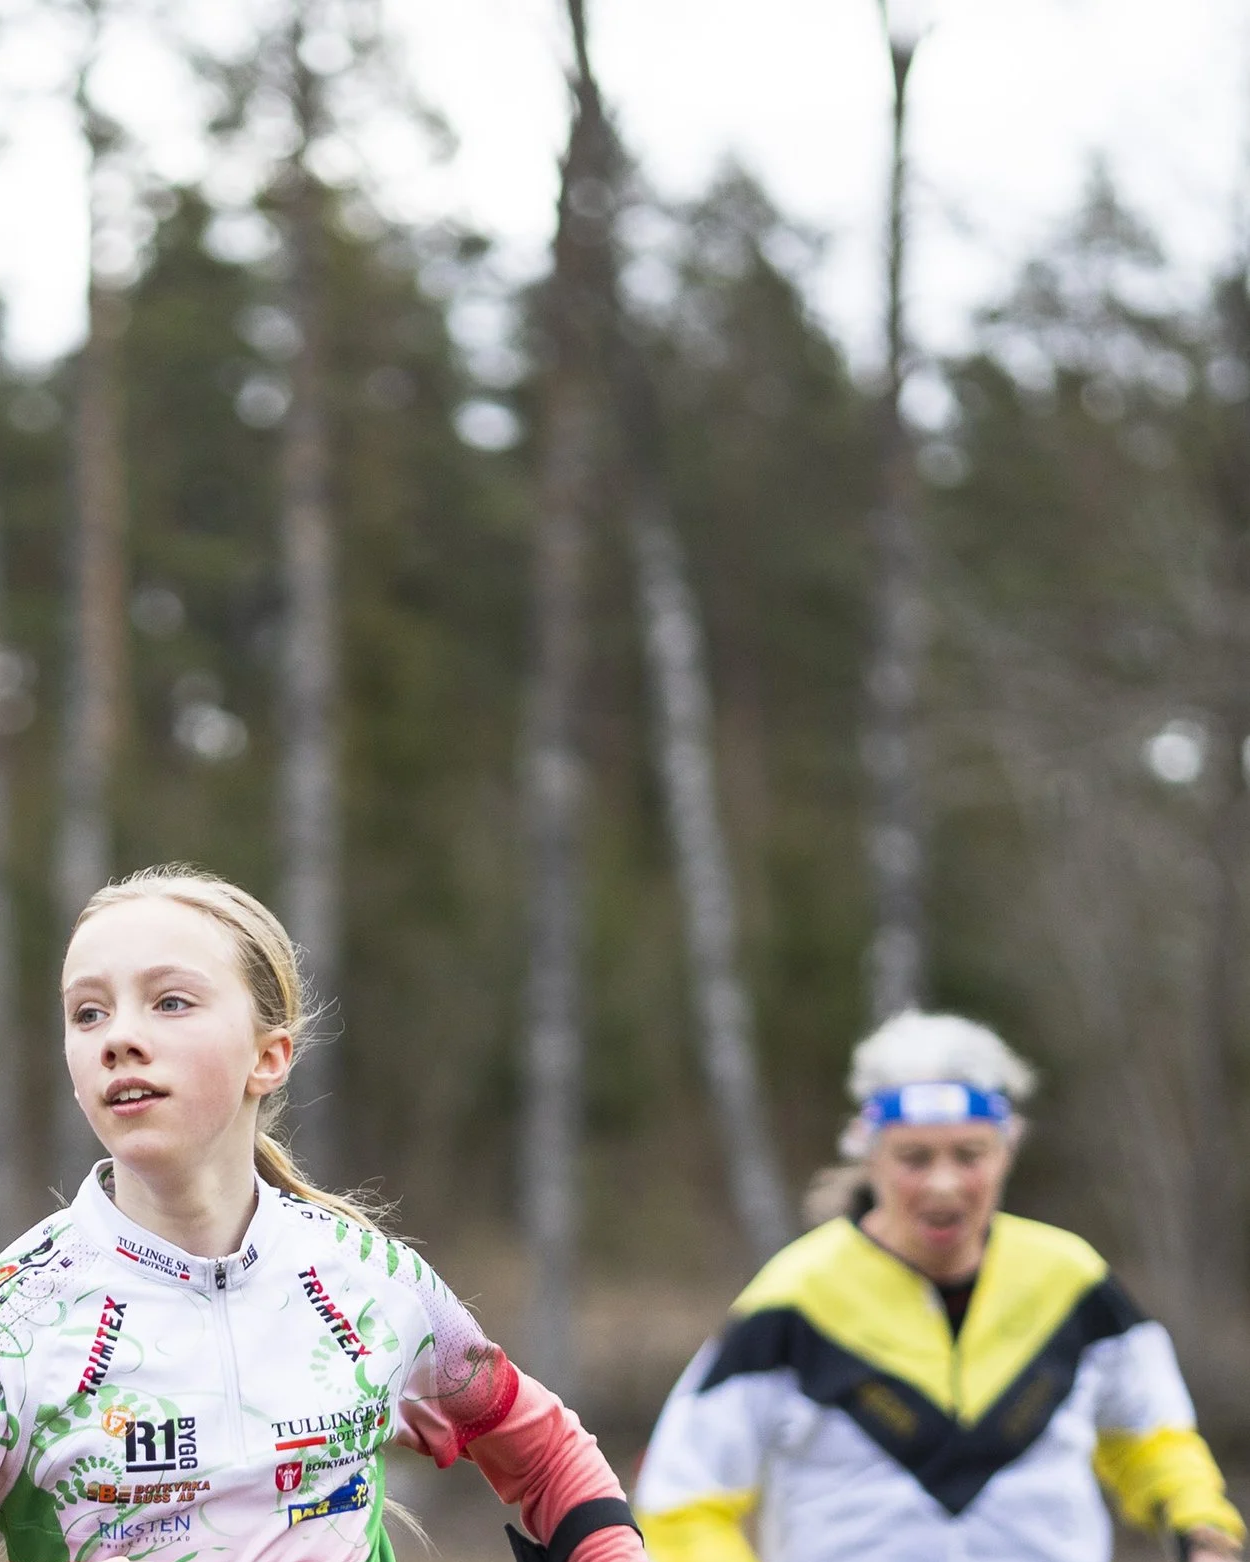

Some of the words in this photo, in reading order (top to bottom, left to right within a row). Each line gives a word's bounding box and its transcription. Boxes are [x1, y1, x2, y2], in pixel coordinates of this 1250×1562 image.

[117, 1236, 175, 1268] TULLINGE
[175, 1259, 190, 1274] SK
[139, 1256, 178, 1278] BOTKYRKA
[298, 1266, 372, 1363] TRIMTEX
[77, 1295, 127, 1396] TRIMTEX
[272, 1405, 376, 1438] TULLINGE
[125, 1418, 176, 1462] R1
[178, 1417, 199, 1470] BYGG
[305, 1455, 355, 1473] BOTKYRKA
[133, 1493, 171, 1504] BUSS
[176, 1492, 196, 1502] AB
[134, 1480, 211, 1494] BOTKYRKA
[99, 1515, 190, 1540] RIKSTEN
